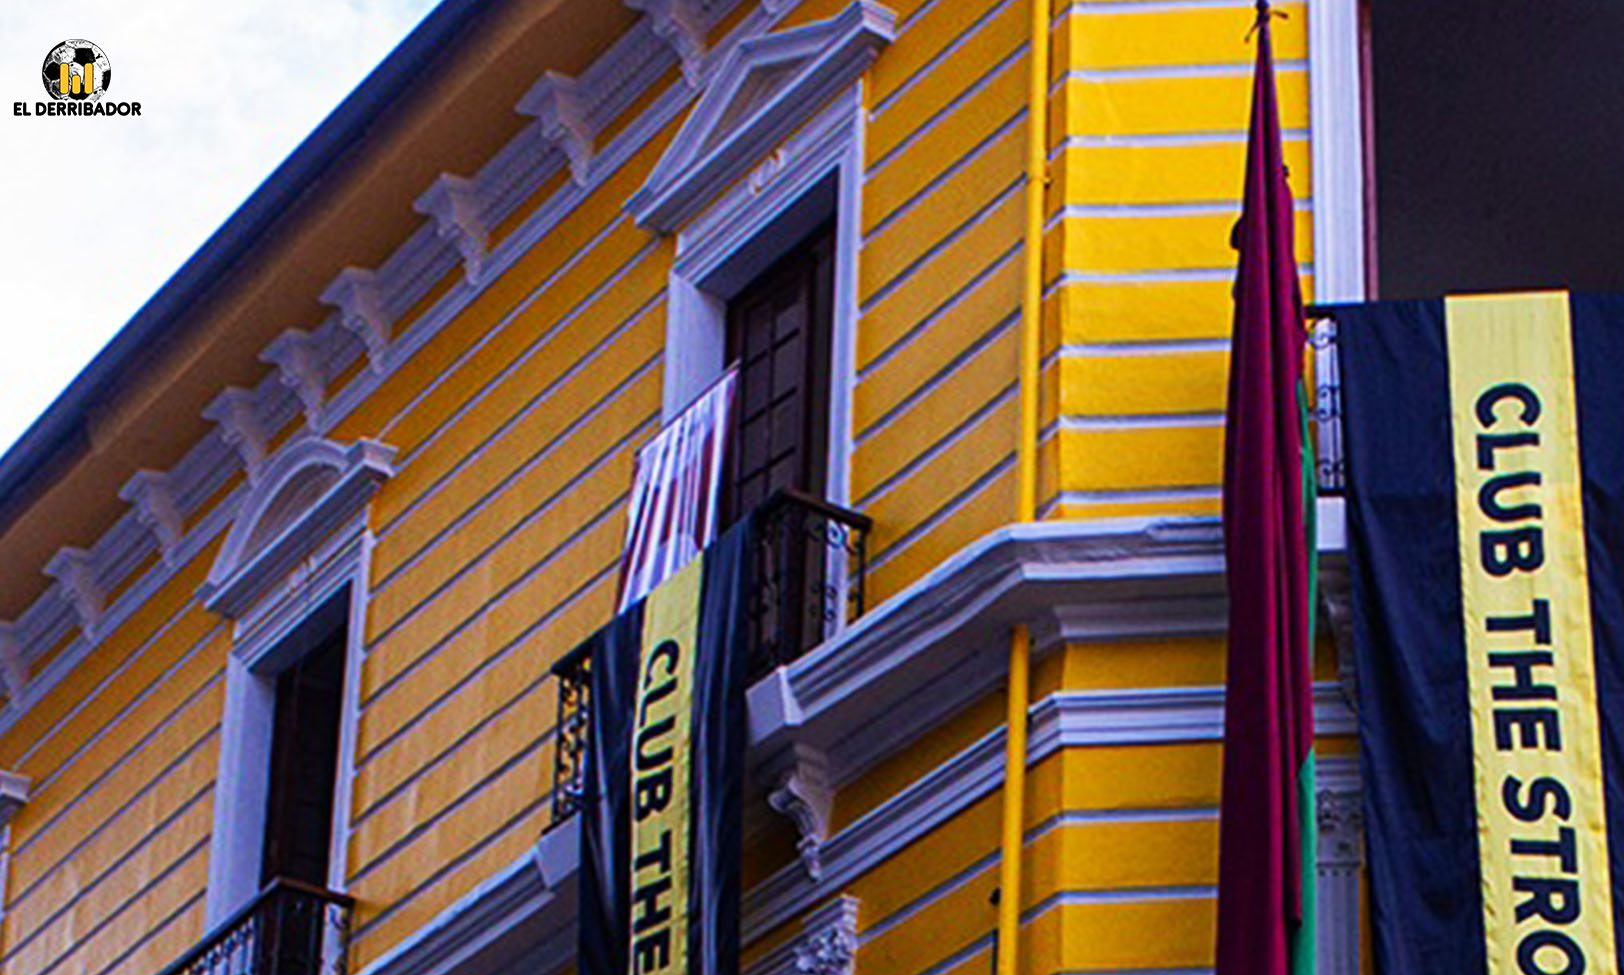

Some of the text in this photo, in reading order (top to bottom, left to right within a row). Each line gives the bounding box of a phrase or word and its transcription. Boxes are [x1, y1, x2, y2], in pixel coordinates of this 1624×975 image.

[1475, 383, 1544, 577] CLUB
[635, 638, 680, 822] CLUB
[1485, 599, 1562, 752] THE
